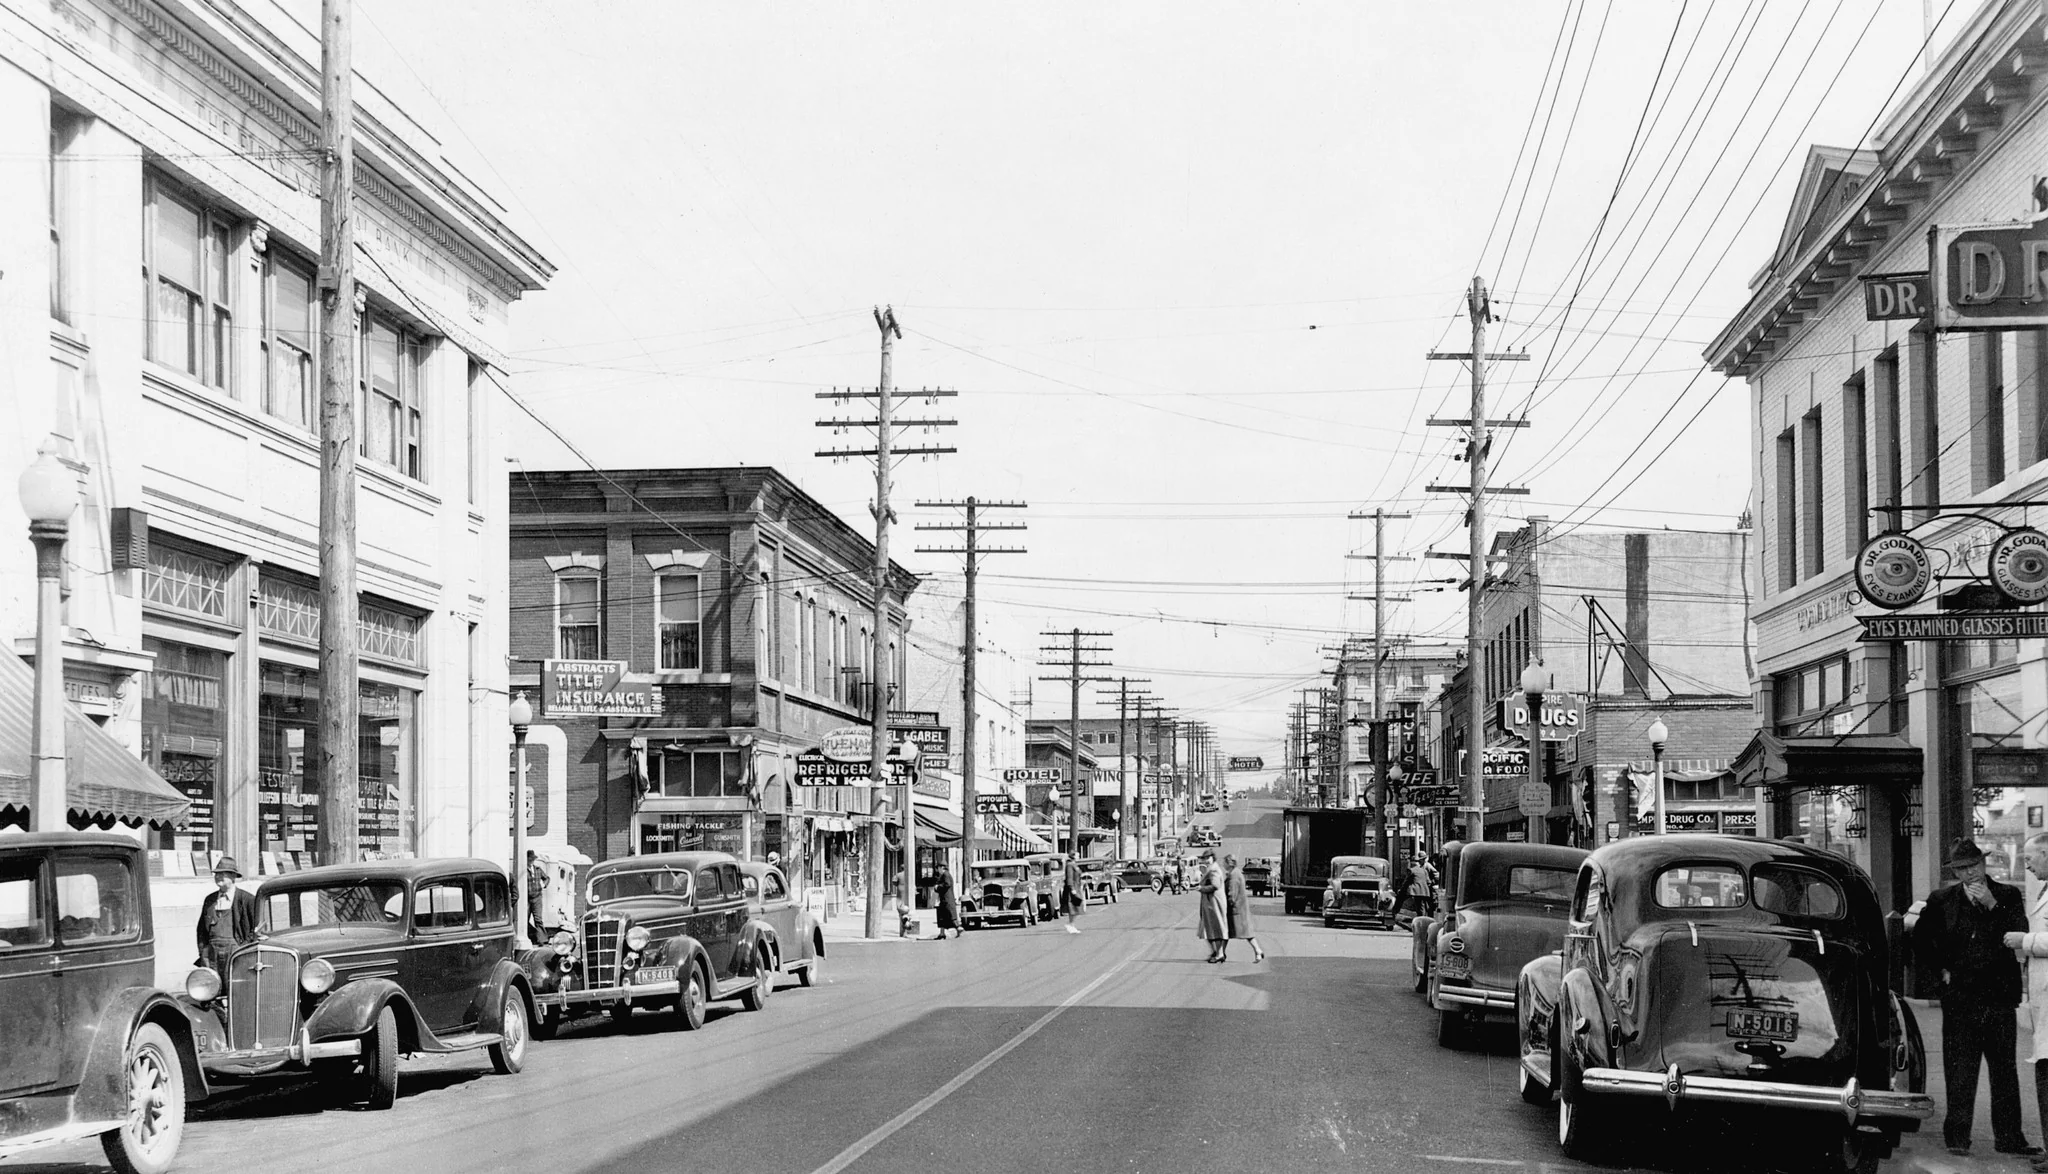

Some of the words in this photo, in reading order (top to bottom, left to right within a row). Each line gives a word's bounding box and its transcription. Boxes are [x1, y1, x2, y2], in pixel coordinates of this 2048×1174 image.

[1873, 282, 1926, 316] DR.
[1864, 573, 1885, 597] EYES
[1885, 570, 1927, 602] EXAMINED
[1997, 568, 2031, 598] GLASSES
[1869, 619, 1896, 637] EYES
[1898, 618, 1958, 637] EXAMINED
[1962, 617, 2014, 636] GLASSES
[556, 663, 616, 673] ABSTRACTS
[556, 674, 604, 687] TITLE
[555, 691, 645, 705] INSURANCE
[605, 705, 641, 713] ABSTRACT
[1515, 707, 1579, 726] DUGS
[910, 731, 946, 742] GABEL
[1403, 708, 1415, 765] LOTUS
[923, 744, 944, 752] MUSIC
[1482, 753, 1524, 763] ACIFIC
[1006, 769, 1059, 780] HOTEL
[1496, 765, 1529, 774] FOOD
[801, 776, 837, 786] KEN
[976, 795, 1008, 803] UPTOWN
[976, 803, 1020, 813] CAFE
[1669, 814, 1695, 824] DRUG
[657, 822, 691, 830] FISHING
[695, 822, 725, 830] TACKLE
[646, 834, 674, 842] LOCKSMITH
[1734, 1014, 1793, 1033] N-5016
